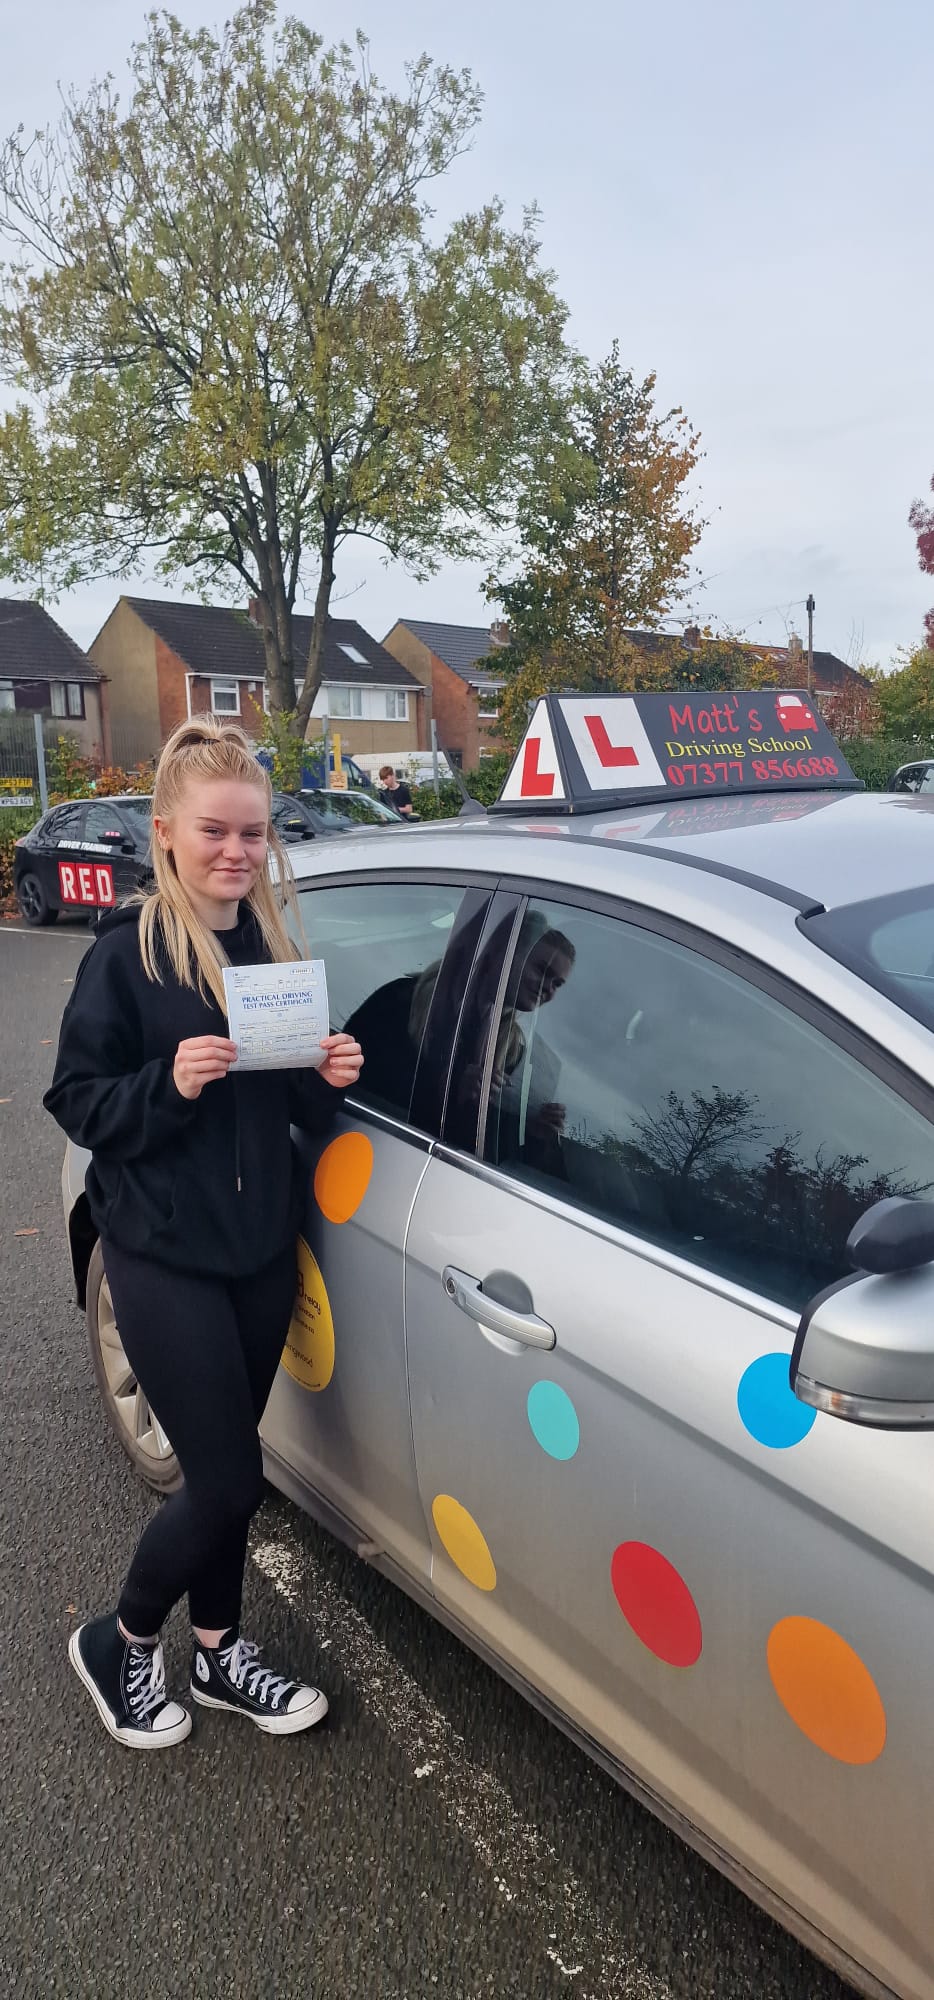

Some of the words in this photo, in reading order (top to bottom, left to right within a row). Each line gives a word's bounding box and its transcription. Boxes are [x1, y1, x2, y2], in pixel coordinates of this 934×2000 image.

[668, 695, 763, 735] Matt's
[583, 715, 640, 768] L
[665, 738, 746, 758] Driving
[747, 735, 812, 754] School
[520, 737, 555, 797] L
[666, 761, 744, 787] 07377
[751, 756, 839, 781] 856688
[58, 840, 81, 850] DRIVER
[80, 843, 112, 853] TRAINING
[61, 867, 113, 902] RED
[242, 995, 280, 1003] PRACTICAL
[281, 990, 313, 1000] DRIVING
[259, 1001, 274, 1009] PASS
[275, 998, 313, 1008] CERTIFICATE
